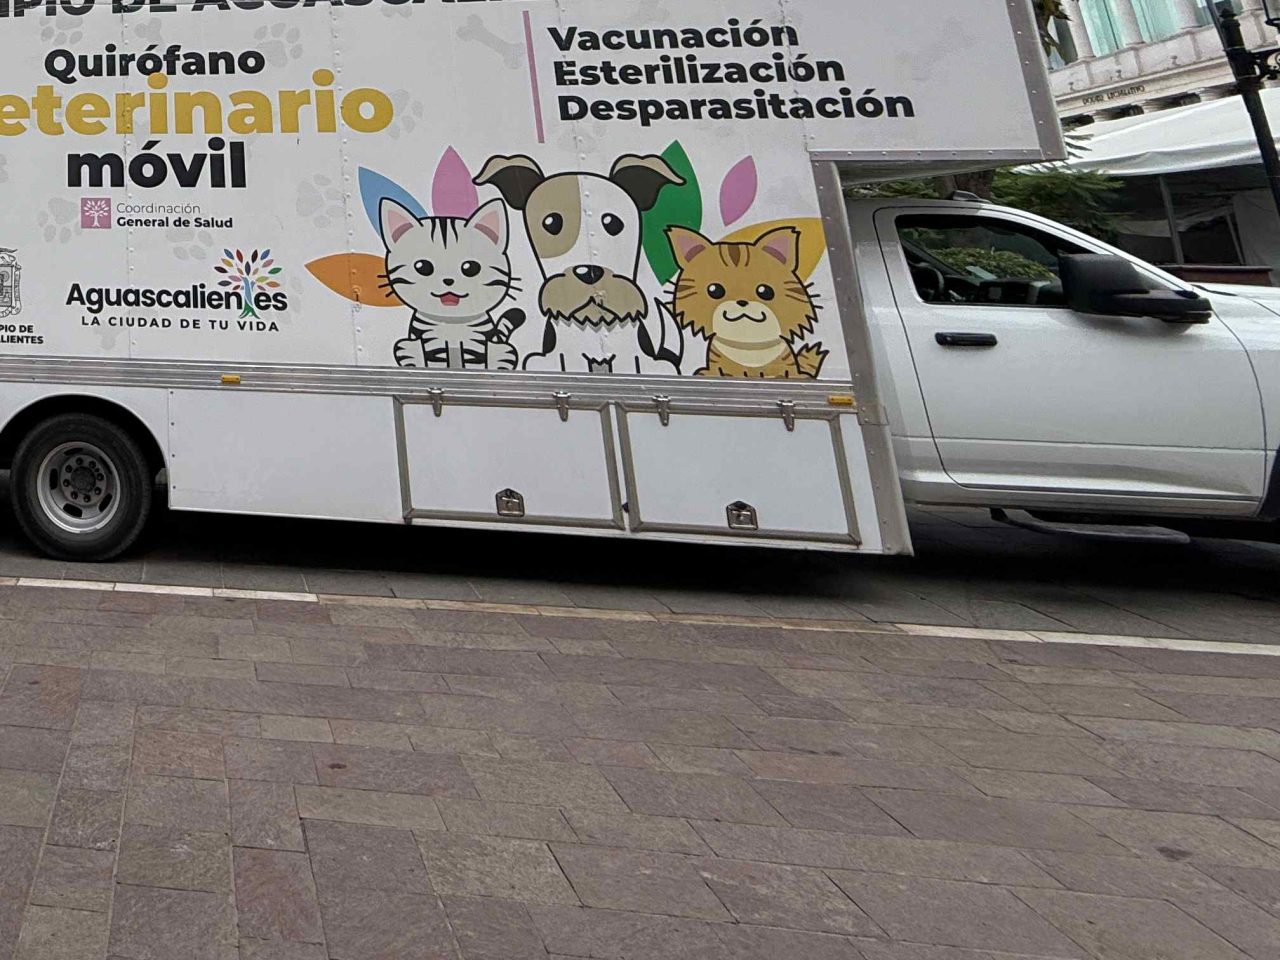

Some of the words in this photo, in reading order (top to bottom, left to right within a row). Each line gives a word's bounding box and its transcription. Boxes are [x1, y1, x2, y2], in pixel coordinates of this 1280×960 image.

[547, 18, 800, 52] Vacunación
[44, 44, 266, 84] Quirófano
[553, 53, 846, 86] Esterilización
[557, 87, 916, 127] Desparasitación
[67, 138, 247, 189] móvil
[116, 203, 201, 215] Coordinación
[116, 216, 170, 228] General
[173, 217, 191, 228] de
[194, 217, 233, 228] Salud
[66, 282, 288, 315] Aguascalientes
[19, 325, 34, 333] DE
[81, 316, 101, 327] LA
[108, 316, 172, 328] CIUDAD
[180, 319, 201, 329] DE
[209, 320, 229, 330] TU
[237, 321, 280, 332] VIDA
